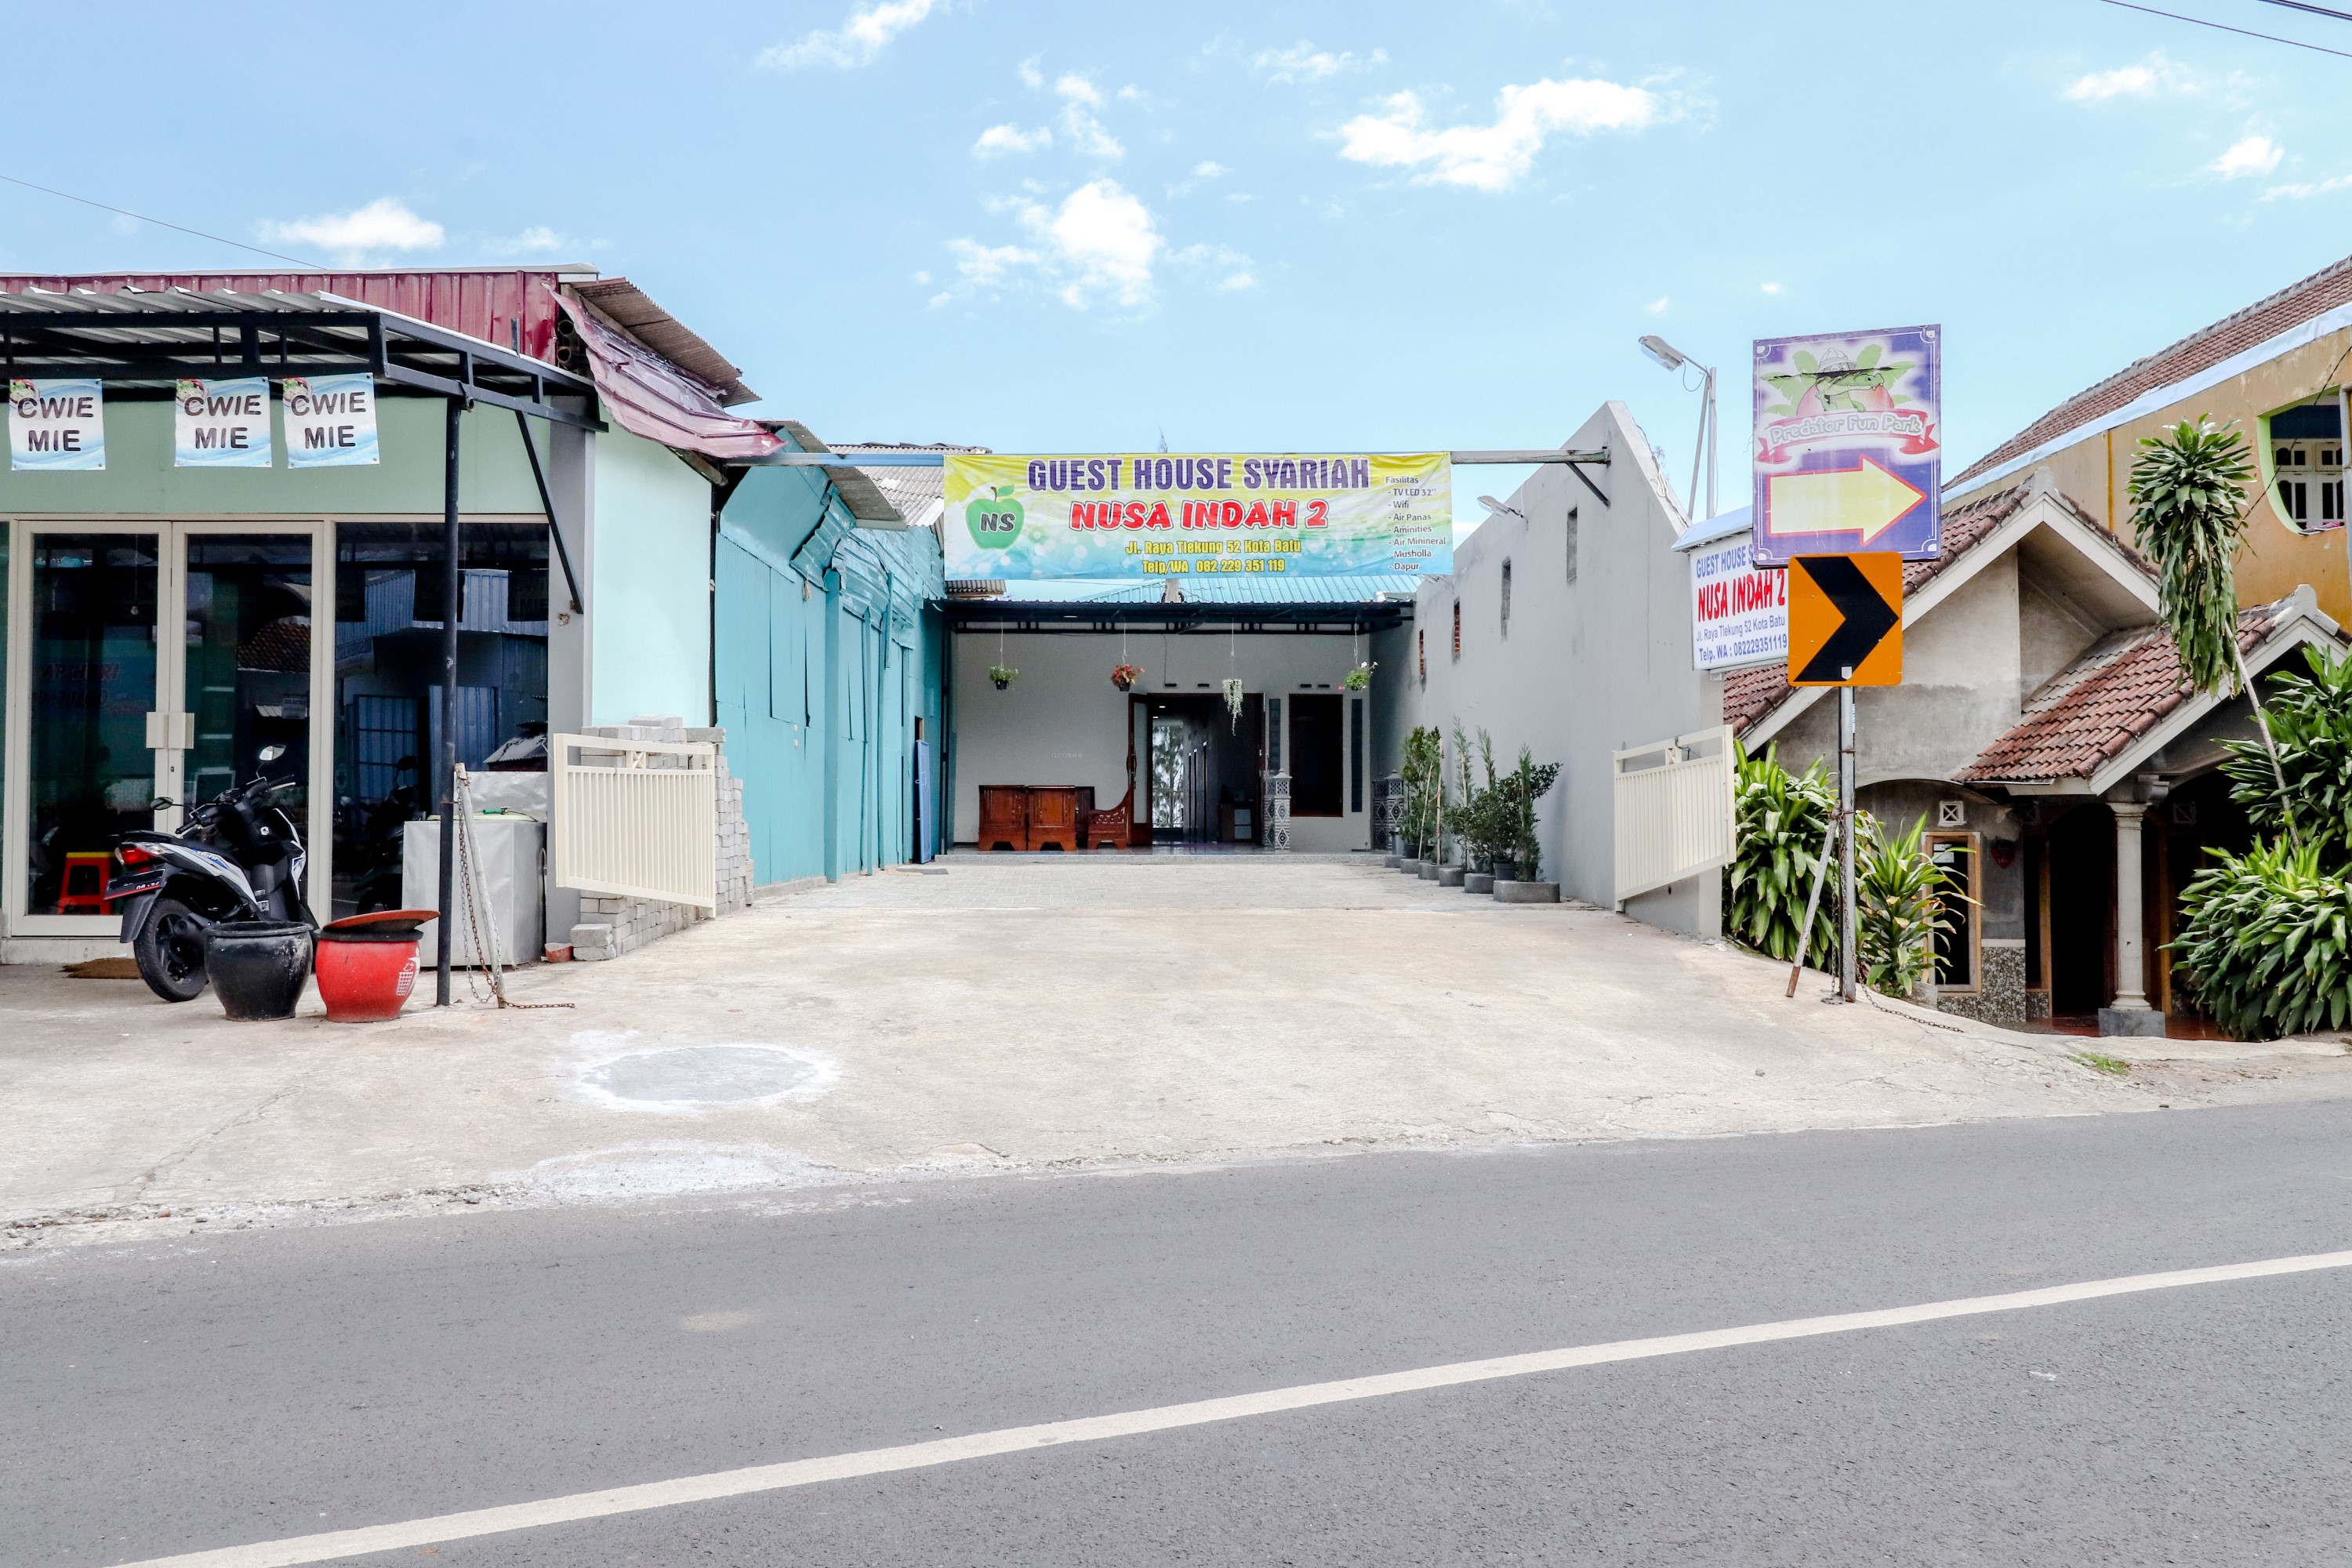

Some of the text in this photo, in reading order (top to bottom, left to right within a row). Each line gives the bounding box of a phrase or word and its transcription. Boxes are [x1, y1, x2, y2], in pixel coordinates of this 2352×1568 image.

[17, 396, 94, 419] CWIE
[183, 394, 262, 418] CWIE
[291, 391, 367, 417] CWIE
[194, 426, 249, 449] MIE
[304, 425, 357, 449] MIE
[1771, 412, 1922, 444] Predator Fun Park
[28, 430, 82, 452] MIE
[1027, 457, 1370, 492] GUEST HOUSE SYARIAH
[1393, 488, 1404, 496] TV
[1405, 488, 1420, 496] LED
[1069, 499, 1330, 532] NUSA INDAH 2
[1393, 500, 1410, 509] Wifi
[980, 512, 1015, 532] NS
[1393, 513, 1404, 521] Air
[1393, 525, 1432, 534] Aminities
[1145, 541, 1174, 555] Raya
[1177, 540, 1223, 554] Tlekung
[1226, 540, 1241, 553] 52
[1244, 539, 1271, 553] Kota
[1274, 539, 1301, 552] Batu
[1394, 549, 1432, 557] Musholla
[1407, 537, 1446, 546] Minineral
[1142, 558, 1285, 575] Telp/WA 082 229 351 119
[1394, 563, 1420, 572] Dapur
[1696, 554, 1719, 579] GUEST
[1721, 545, 1746, 572] HOUSE
[1698, 568, 1786, 622] NUSA INDAH 2
[1704, 628, 1718, 642] Raya
[1719, 625, 1743, 638] Tlekung
[1744, 622, 1752, 633] 52
[1753, 618, 1768, 630] Kota
[1769, 615, 1786, 628] Batu
[1699, 646, 1715, 663] Telp.
[1716, 644, 1729, 659] WA
[1733, 633, 1788, 656] 082229351119
